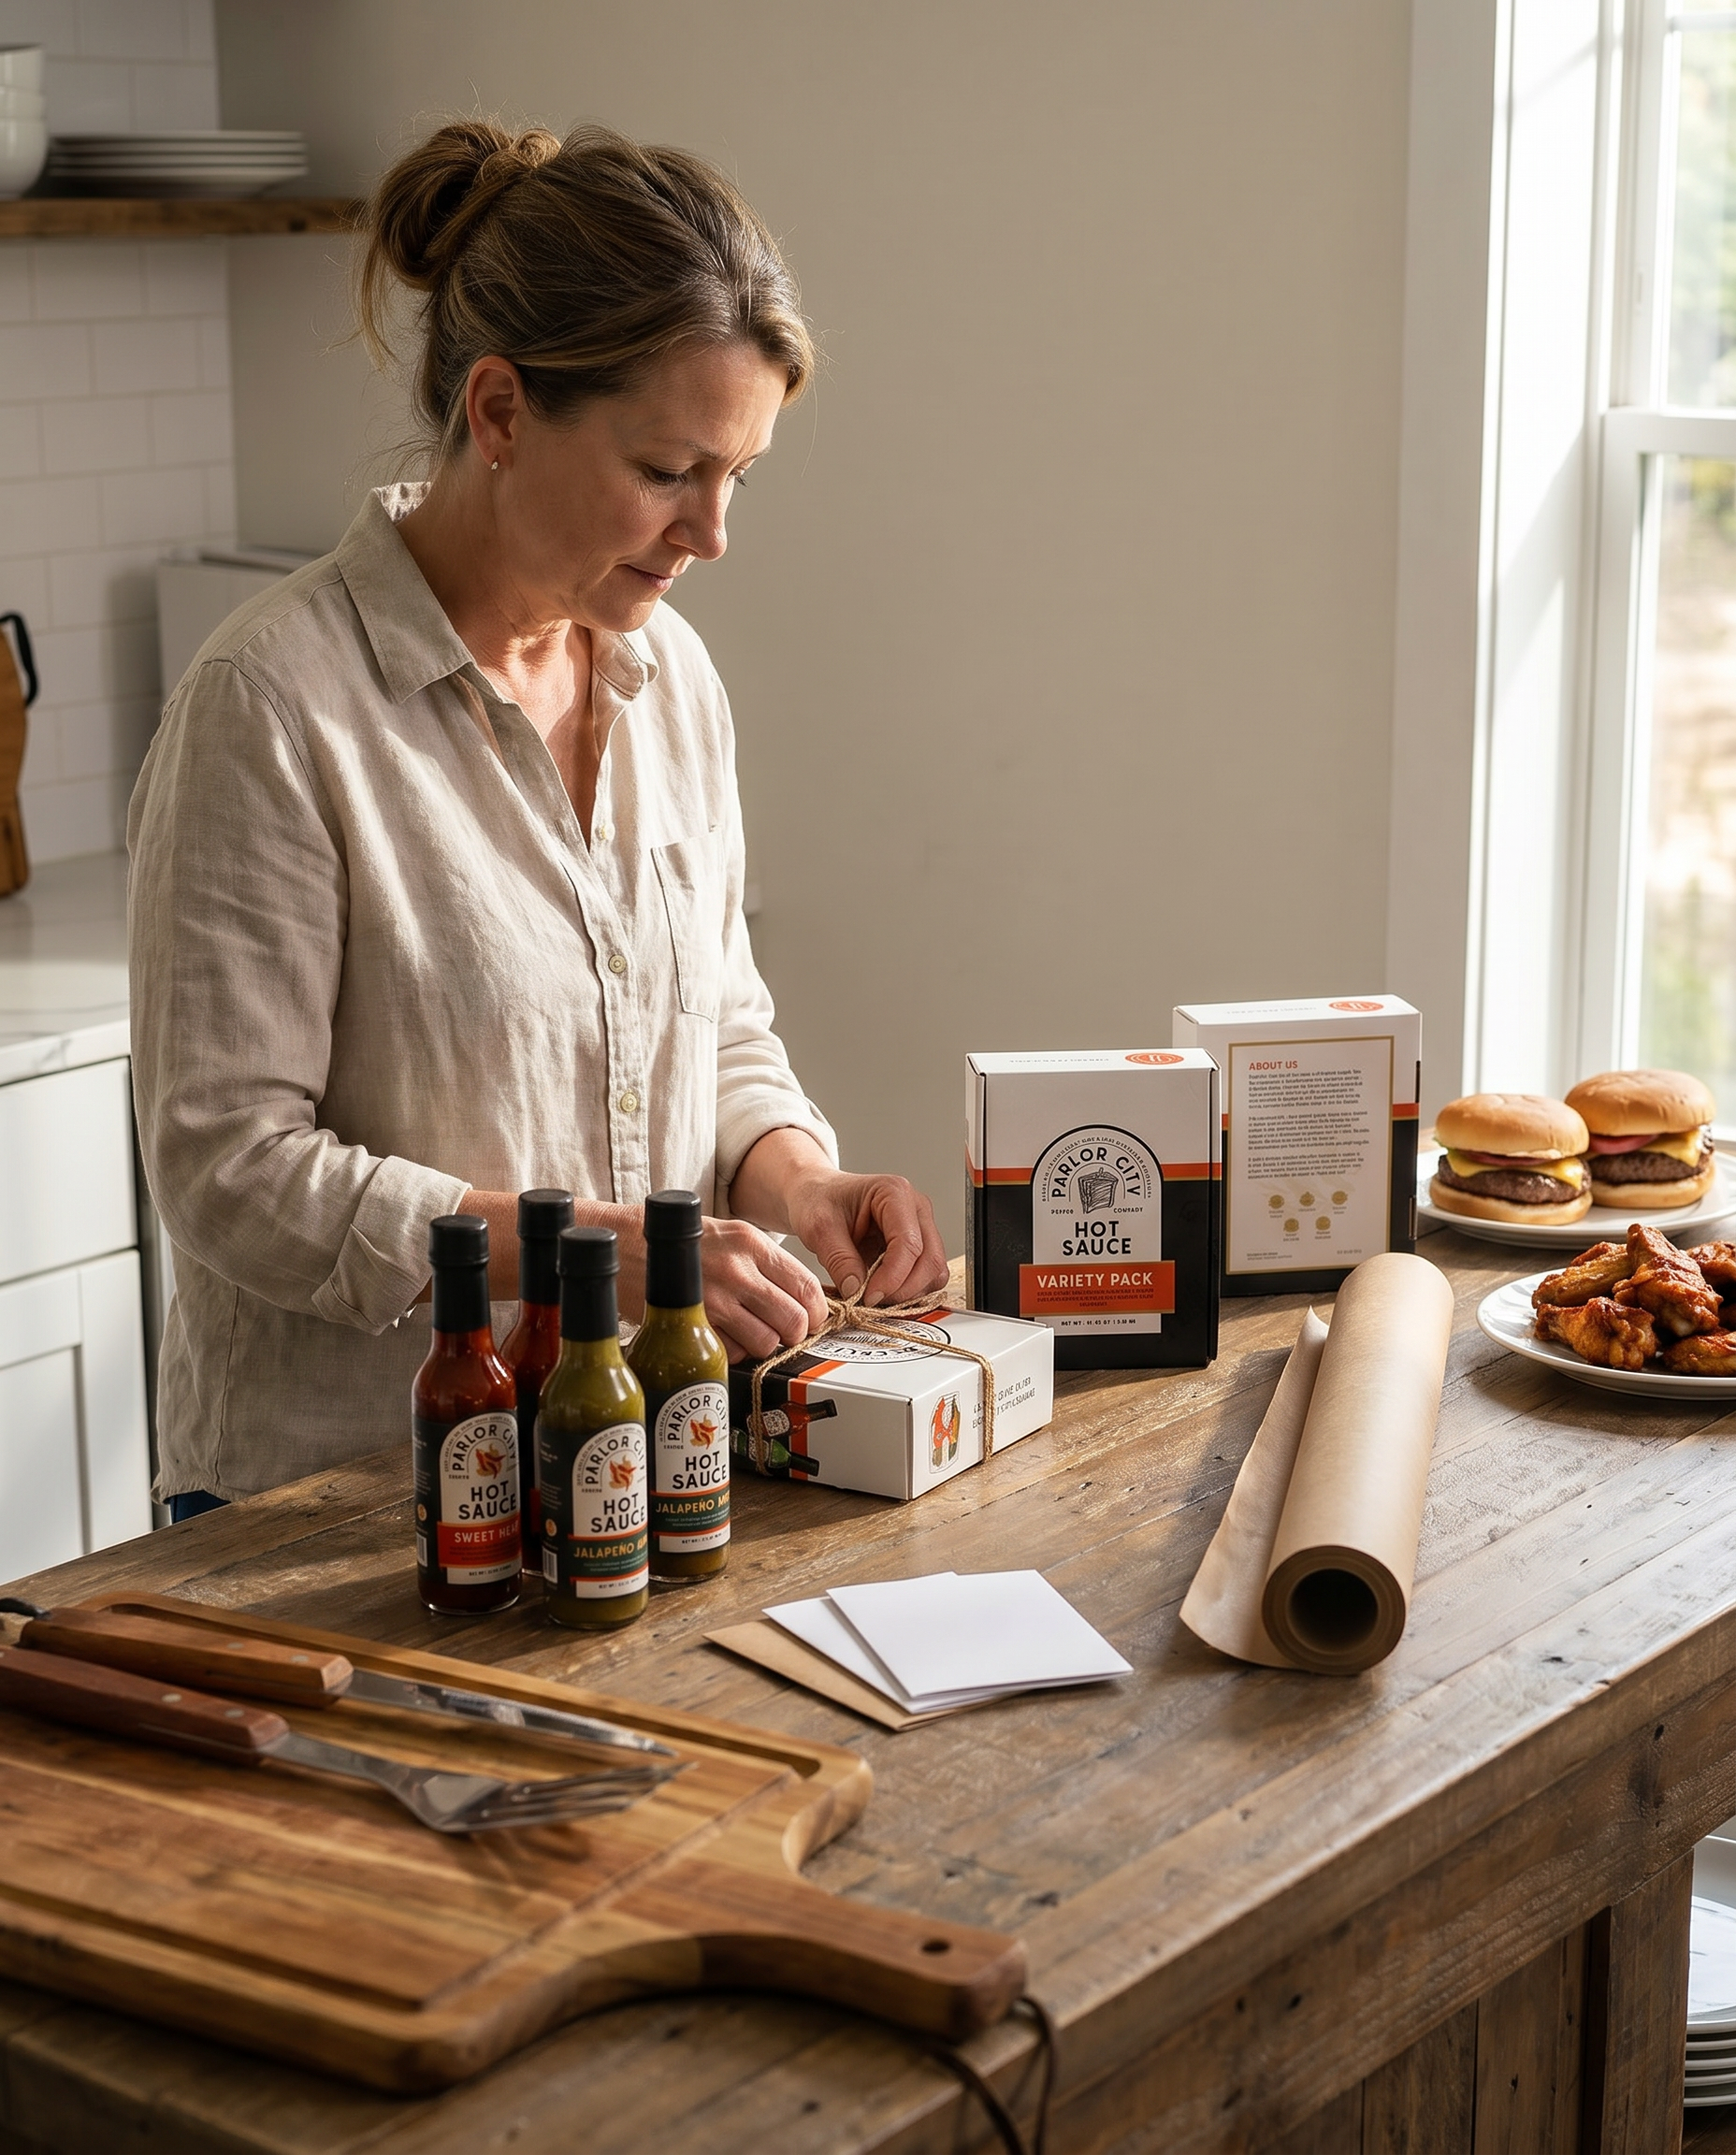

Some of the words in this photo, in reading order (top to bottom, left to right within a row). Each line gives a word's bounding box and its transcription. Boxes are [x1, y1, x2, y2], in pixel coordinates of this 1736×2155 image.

[1249, 1061, 1282, 1071] ABOUT
[1285, 1061, 1298, 1069] US
[1051, 1147, 1107, 1198] PARLOR
[1115, 1156, 1141, 1195] CITY
[1075, 1221, 1120, 1237] HOT
[1063, 1237, 1132, 1256] SAUCE
[1036, 1273, 1106, 1288] VARIETY
[1110, 1272, 1153, 1286] PACK
[667, 1395, 711, 1441] PARLOR
[452, 1424, 498, 1471] PARLOR
[585, 1436, 629, 1484] PARLOR
[685, 1451, 720, 1471] HOT
[672, 1464, 727, 1490] SAUCE
[470, 1481, 509, 1502] HOT
[458, 1493, 516, 1520] SAUCE
[603, 1493, 639, 1515] HOT
[590, 1505, 645, 1533] SAUCE
[454, 1530, 495, 1543] SWEET
